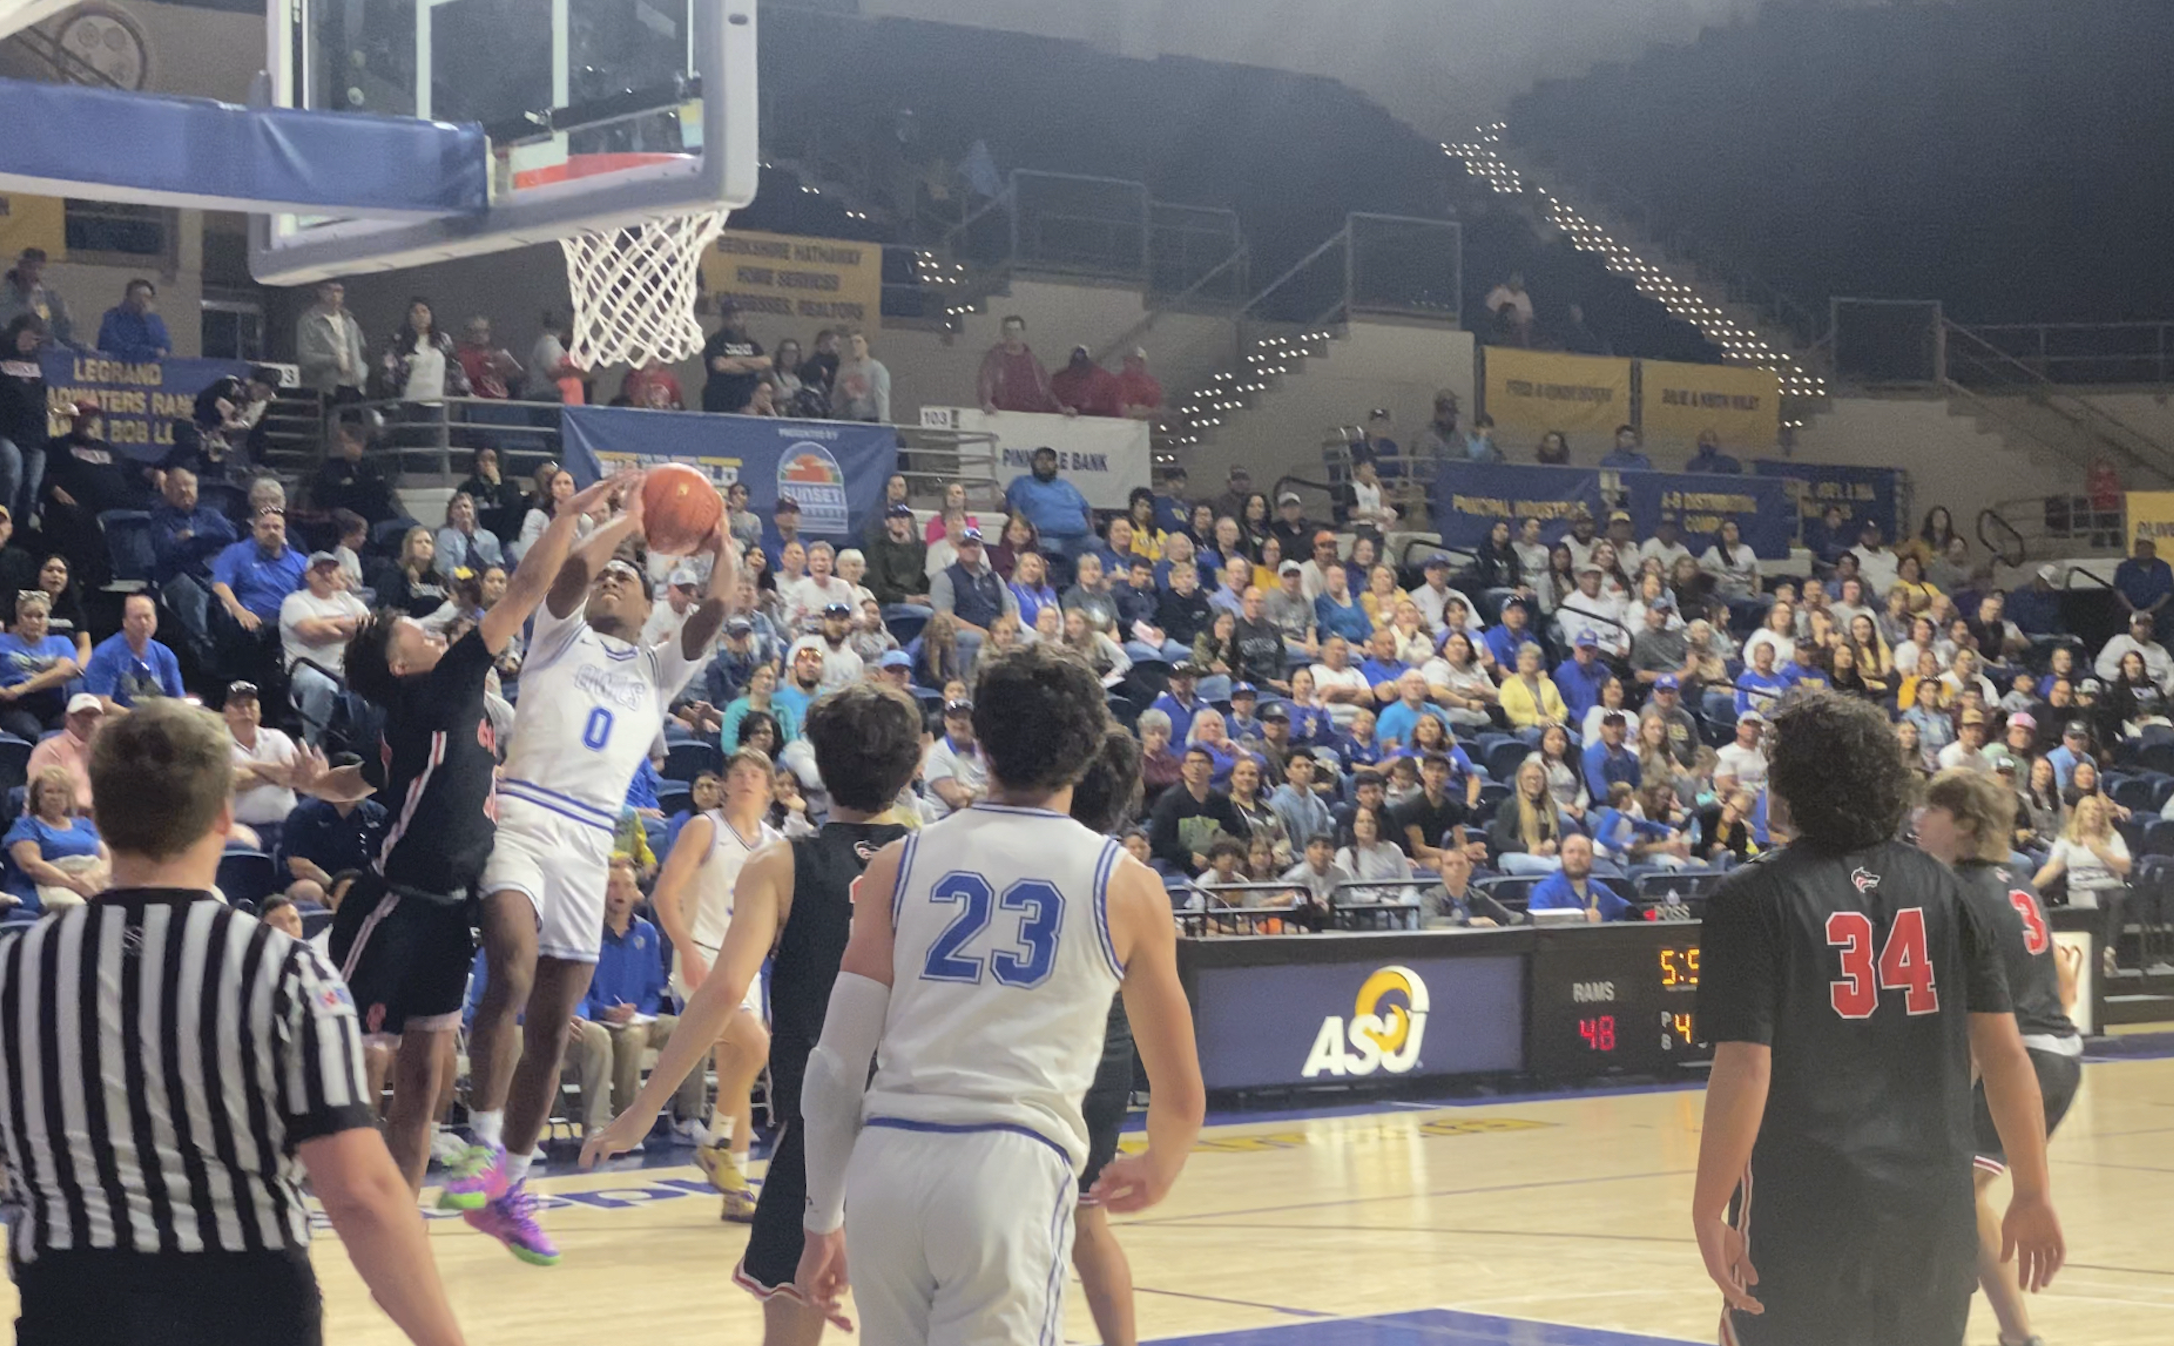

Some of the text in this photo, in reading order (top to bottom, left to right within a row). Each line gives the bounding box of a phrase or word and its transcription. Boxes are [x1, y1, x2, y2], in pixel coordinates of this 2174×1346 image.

[73, 357, 162, 386] LEGRAND
[110, 419, 149, 444] BOB
[923, 410, 948, 426] 103
[1072, 451, 1109, 472] BANK
[781, 486, 841, 504] SUNSET
[582, 706, 614, 752] 0
[919, 870, 1066, 990] 23
[1825, 907, 1940, 1019] 34
[1572, 981, 1615, 1003] RAMS
[1301, 988, 1428, 1077] ASU
[1579, 1015, 1615, 1050] 48
[1674, 1013, 1693, 1044] 4
